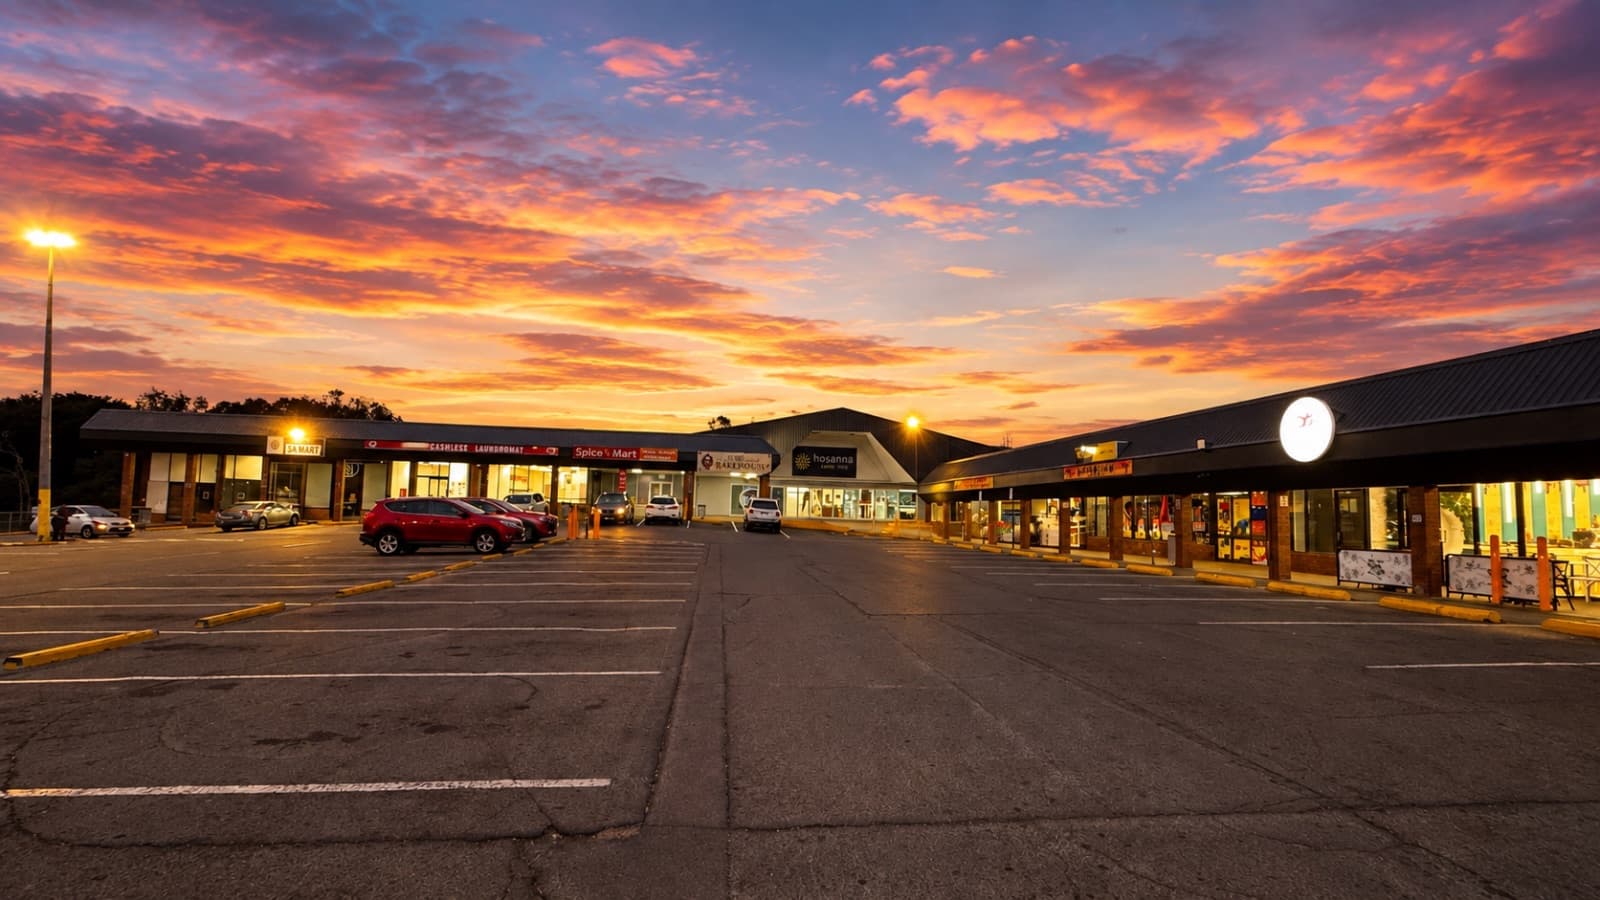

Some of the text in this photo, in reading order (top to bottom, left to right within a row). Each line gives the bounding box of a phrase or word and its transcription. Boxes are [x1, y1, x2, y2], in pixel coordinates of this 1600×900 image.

[298, 445, 320, 455] MART
[430, 443, 524, 454] CASHLESS LAUNDROMAT
[575, 447, 603, 458] Spice
[612, 449, 637, 458] Mart
[813, 453, 854, 464] hosanna
